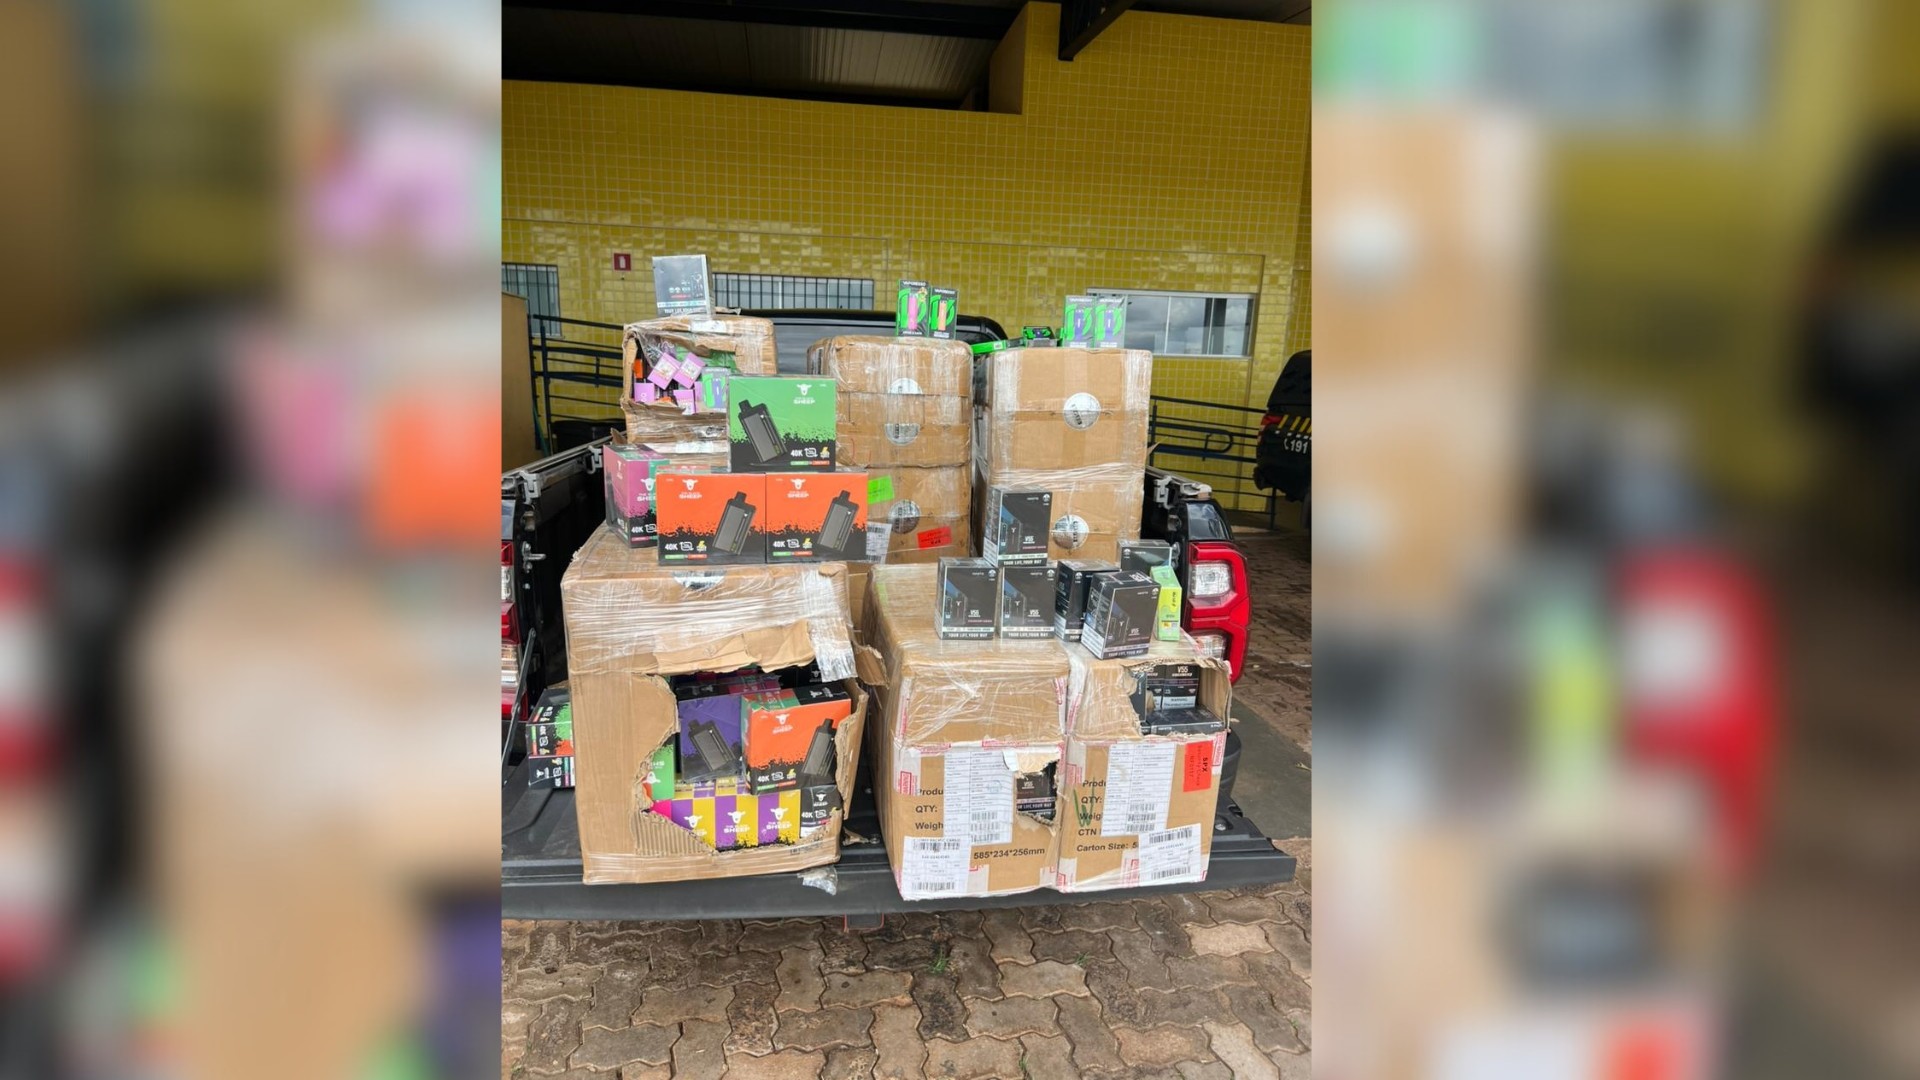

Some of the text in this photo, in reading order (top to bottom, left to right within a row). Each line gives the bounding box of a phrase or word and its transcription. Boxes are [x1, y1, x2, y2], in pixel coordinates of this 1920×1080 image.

[1290, 440, 1308, 454] 191
[915, 805, 938, 814] QTY:
[1077, 844, 1106, 852] Carton
[1108, 842, 1128, 850] Size:
